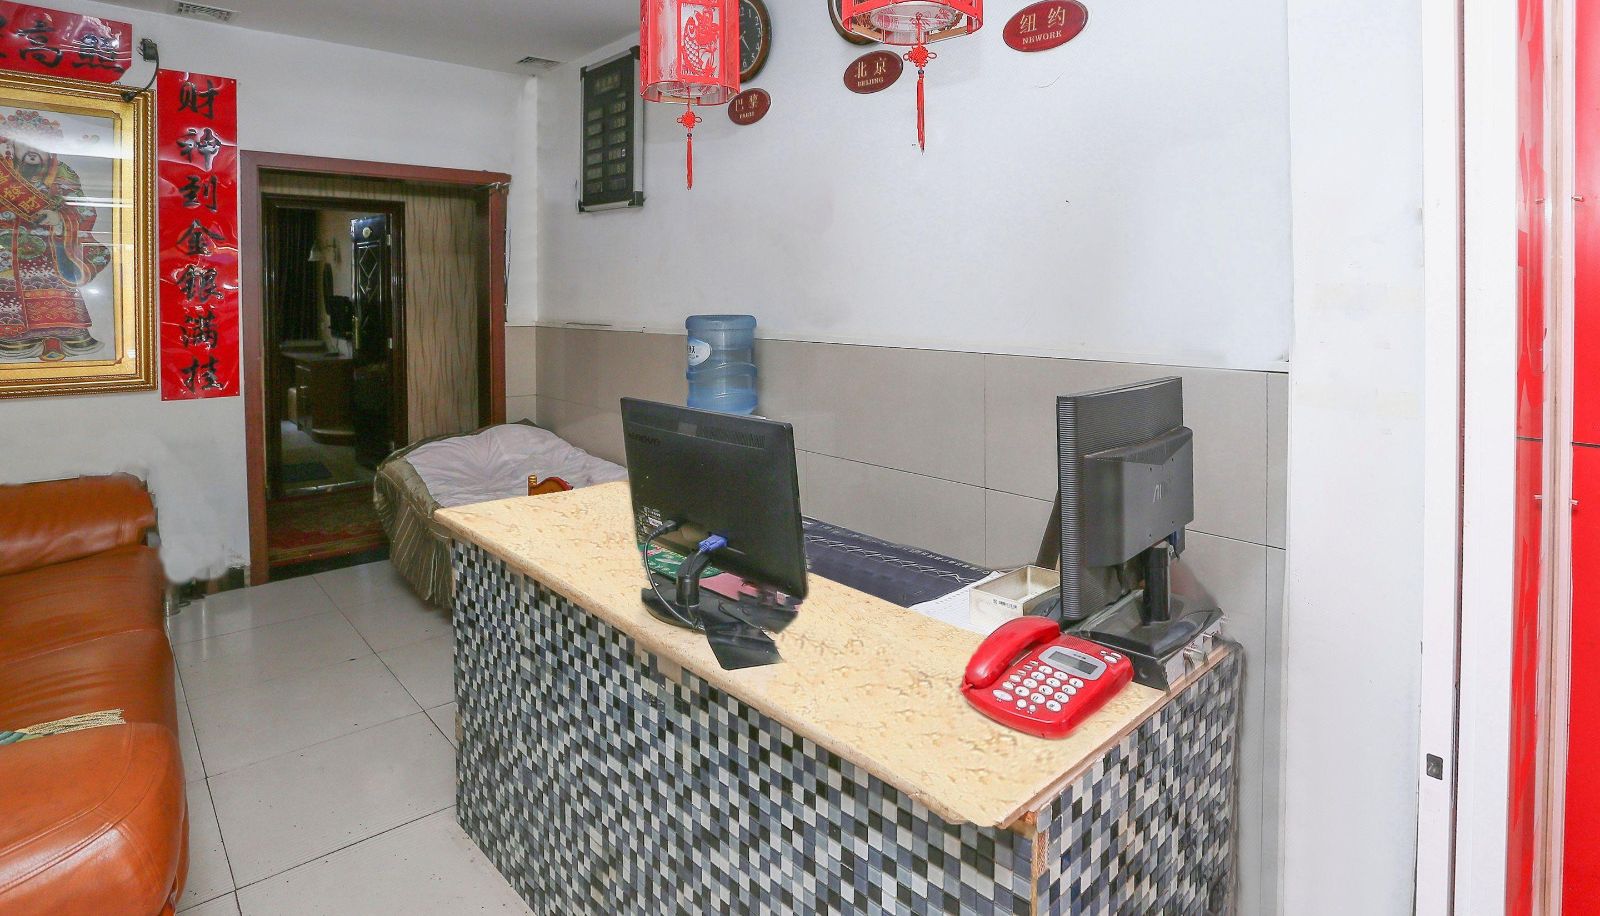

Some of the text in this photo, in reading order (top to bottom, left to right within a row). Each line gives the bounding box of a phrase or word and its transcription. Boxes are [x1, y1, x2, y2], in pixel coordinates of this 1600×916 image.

[1020, 6, 1065, 34] 纽约
[0, 16, 126, 73] 高照
[1022, 30, 1062, 45] NEWORK
[854, 57, 887, 79] 北京
